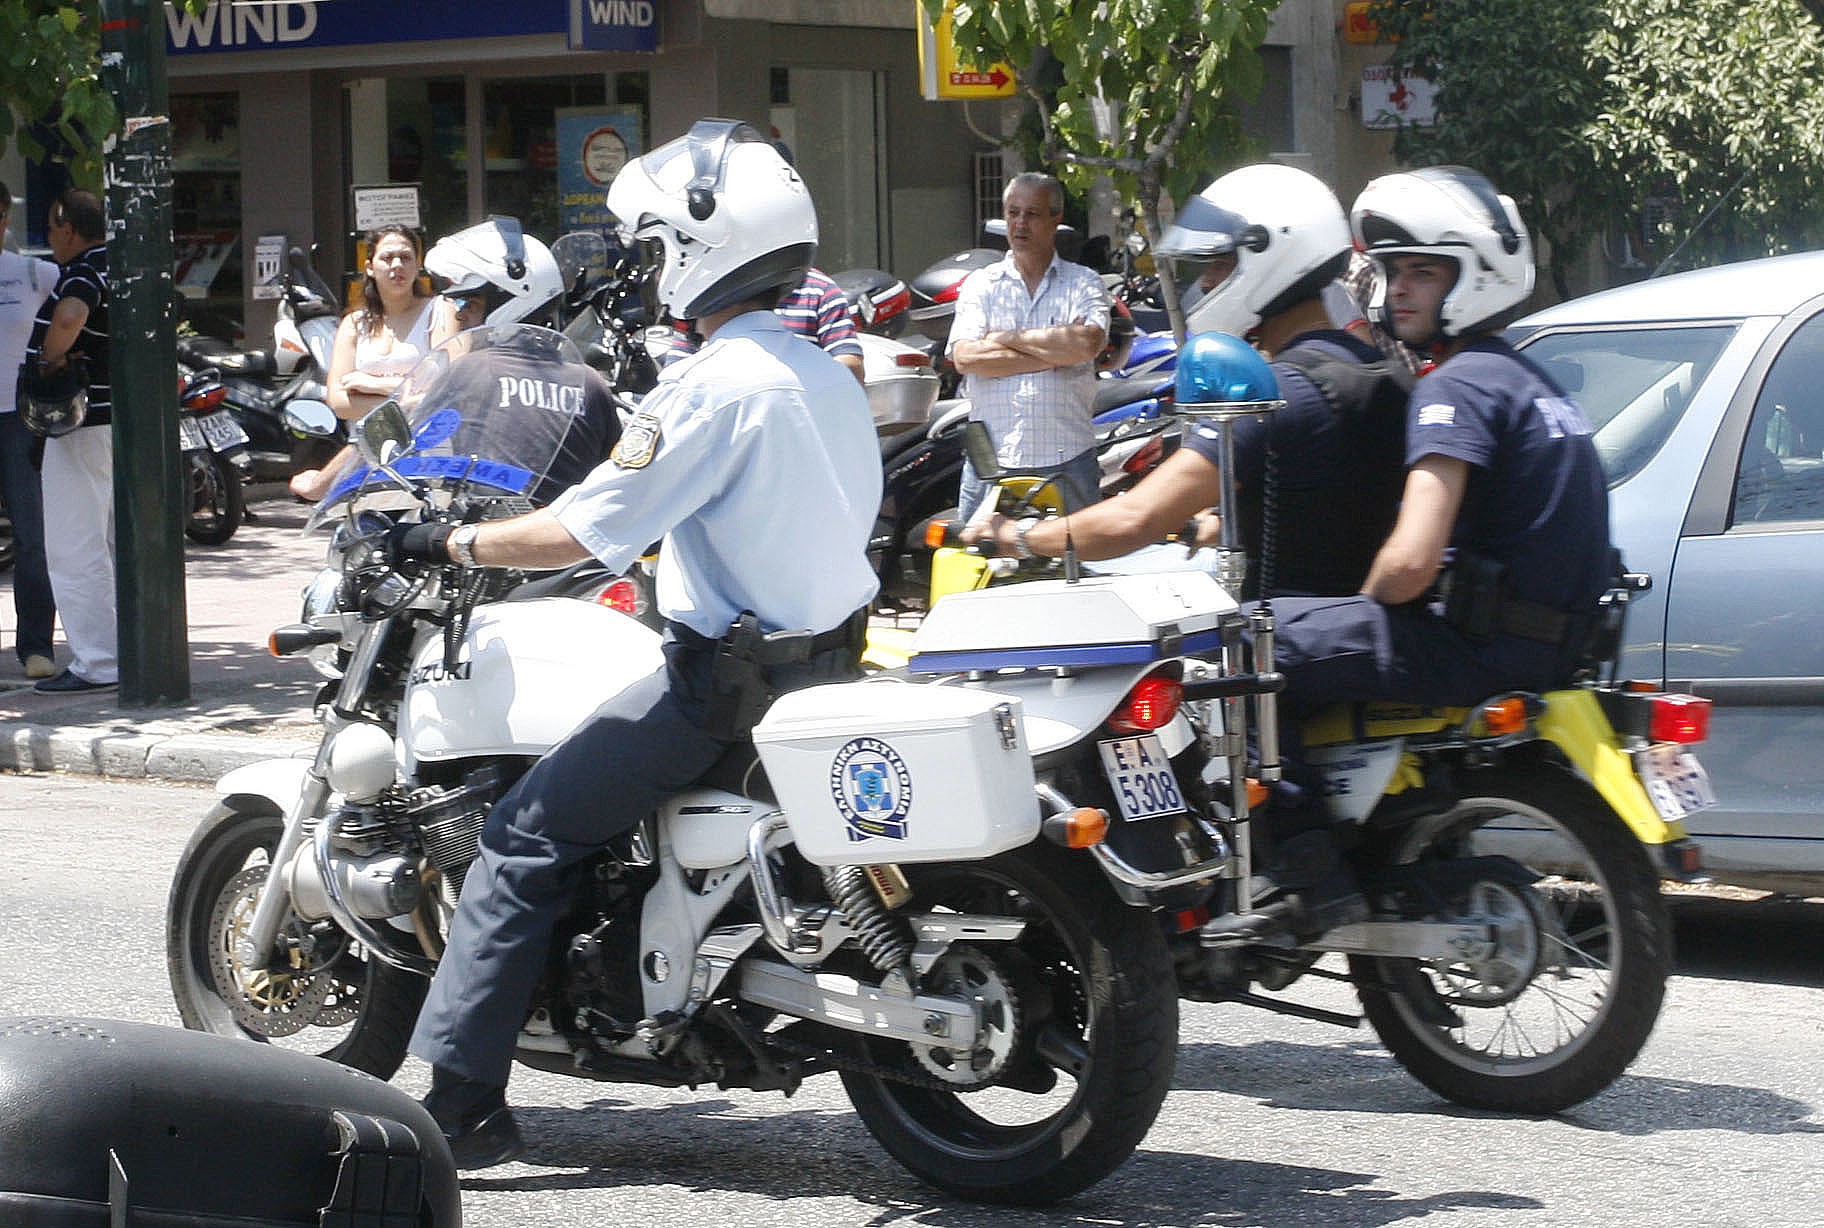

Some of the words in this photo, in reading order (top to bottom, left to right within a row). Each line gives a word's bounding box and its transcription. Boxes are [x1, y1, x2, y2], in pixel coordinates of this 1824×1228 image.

[163, 1, 318, 48] WIND
[588, 0, 654, 27] WIND
[499, 377, 586, 416] POLICE
[1118, 771, 1180, 814] 5308
